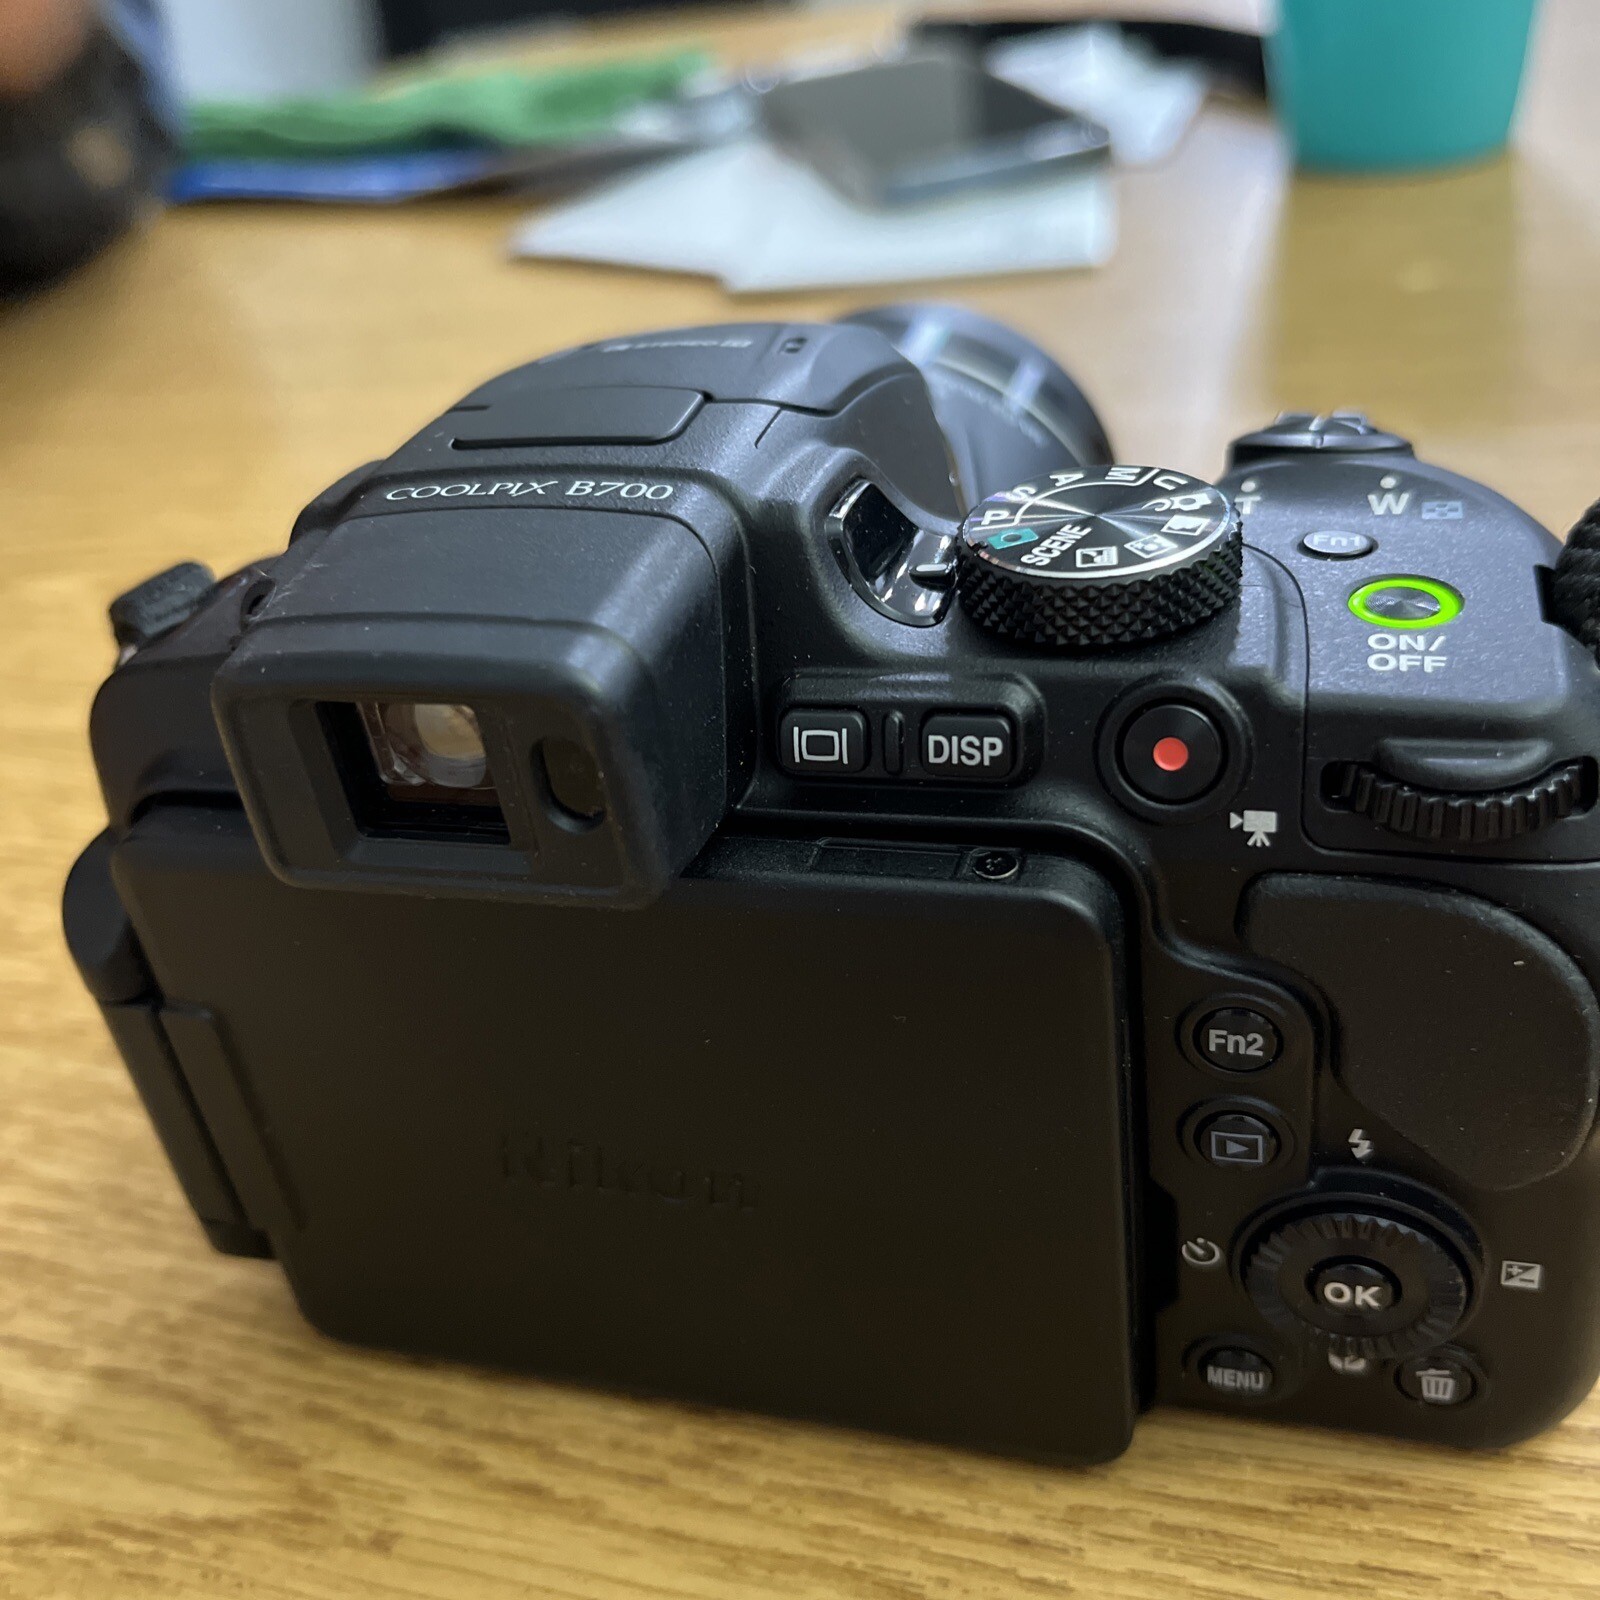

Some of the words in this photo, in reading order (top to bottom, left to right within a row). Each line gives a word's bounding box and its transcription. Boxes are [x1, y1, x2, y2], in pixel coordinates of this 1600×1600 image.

[1050, 473, 1085, 487] A
[1105, 467, 1141, 481] M
[1153, 475, 1188, 491] U
[386, 480, 559, 500] COOLPIX
[566, 480, 674, 500] B700
[1005, 486, 1037, 502] S
[1234, 496, 1262, 515] T
[1367, 493, 1410, 515] W
[981, 510, 1010, 526] P
[1020, 524, 1092, 567] SCENE
[1312, 534, 1361, 547] Fn1
[1367, 633, 1446, 651] ON/
[1367, 653, 1447, 672] OFF
[928, 734, 1004, 766] DISP
[1208, 1028, 1264, 1056] Fn2
[1323, 1281, 1382, 1310] OK
[1206, 1366, 1265, 1391] MENU
